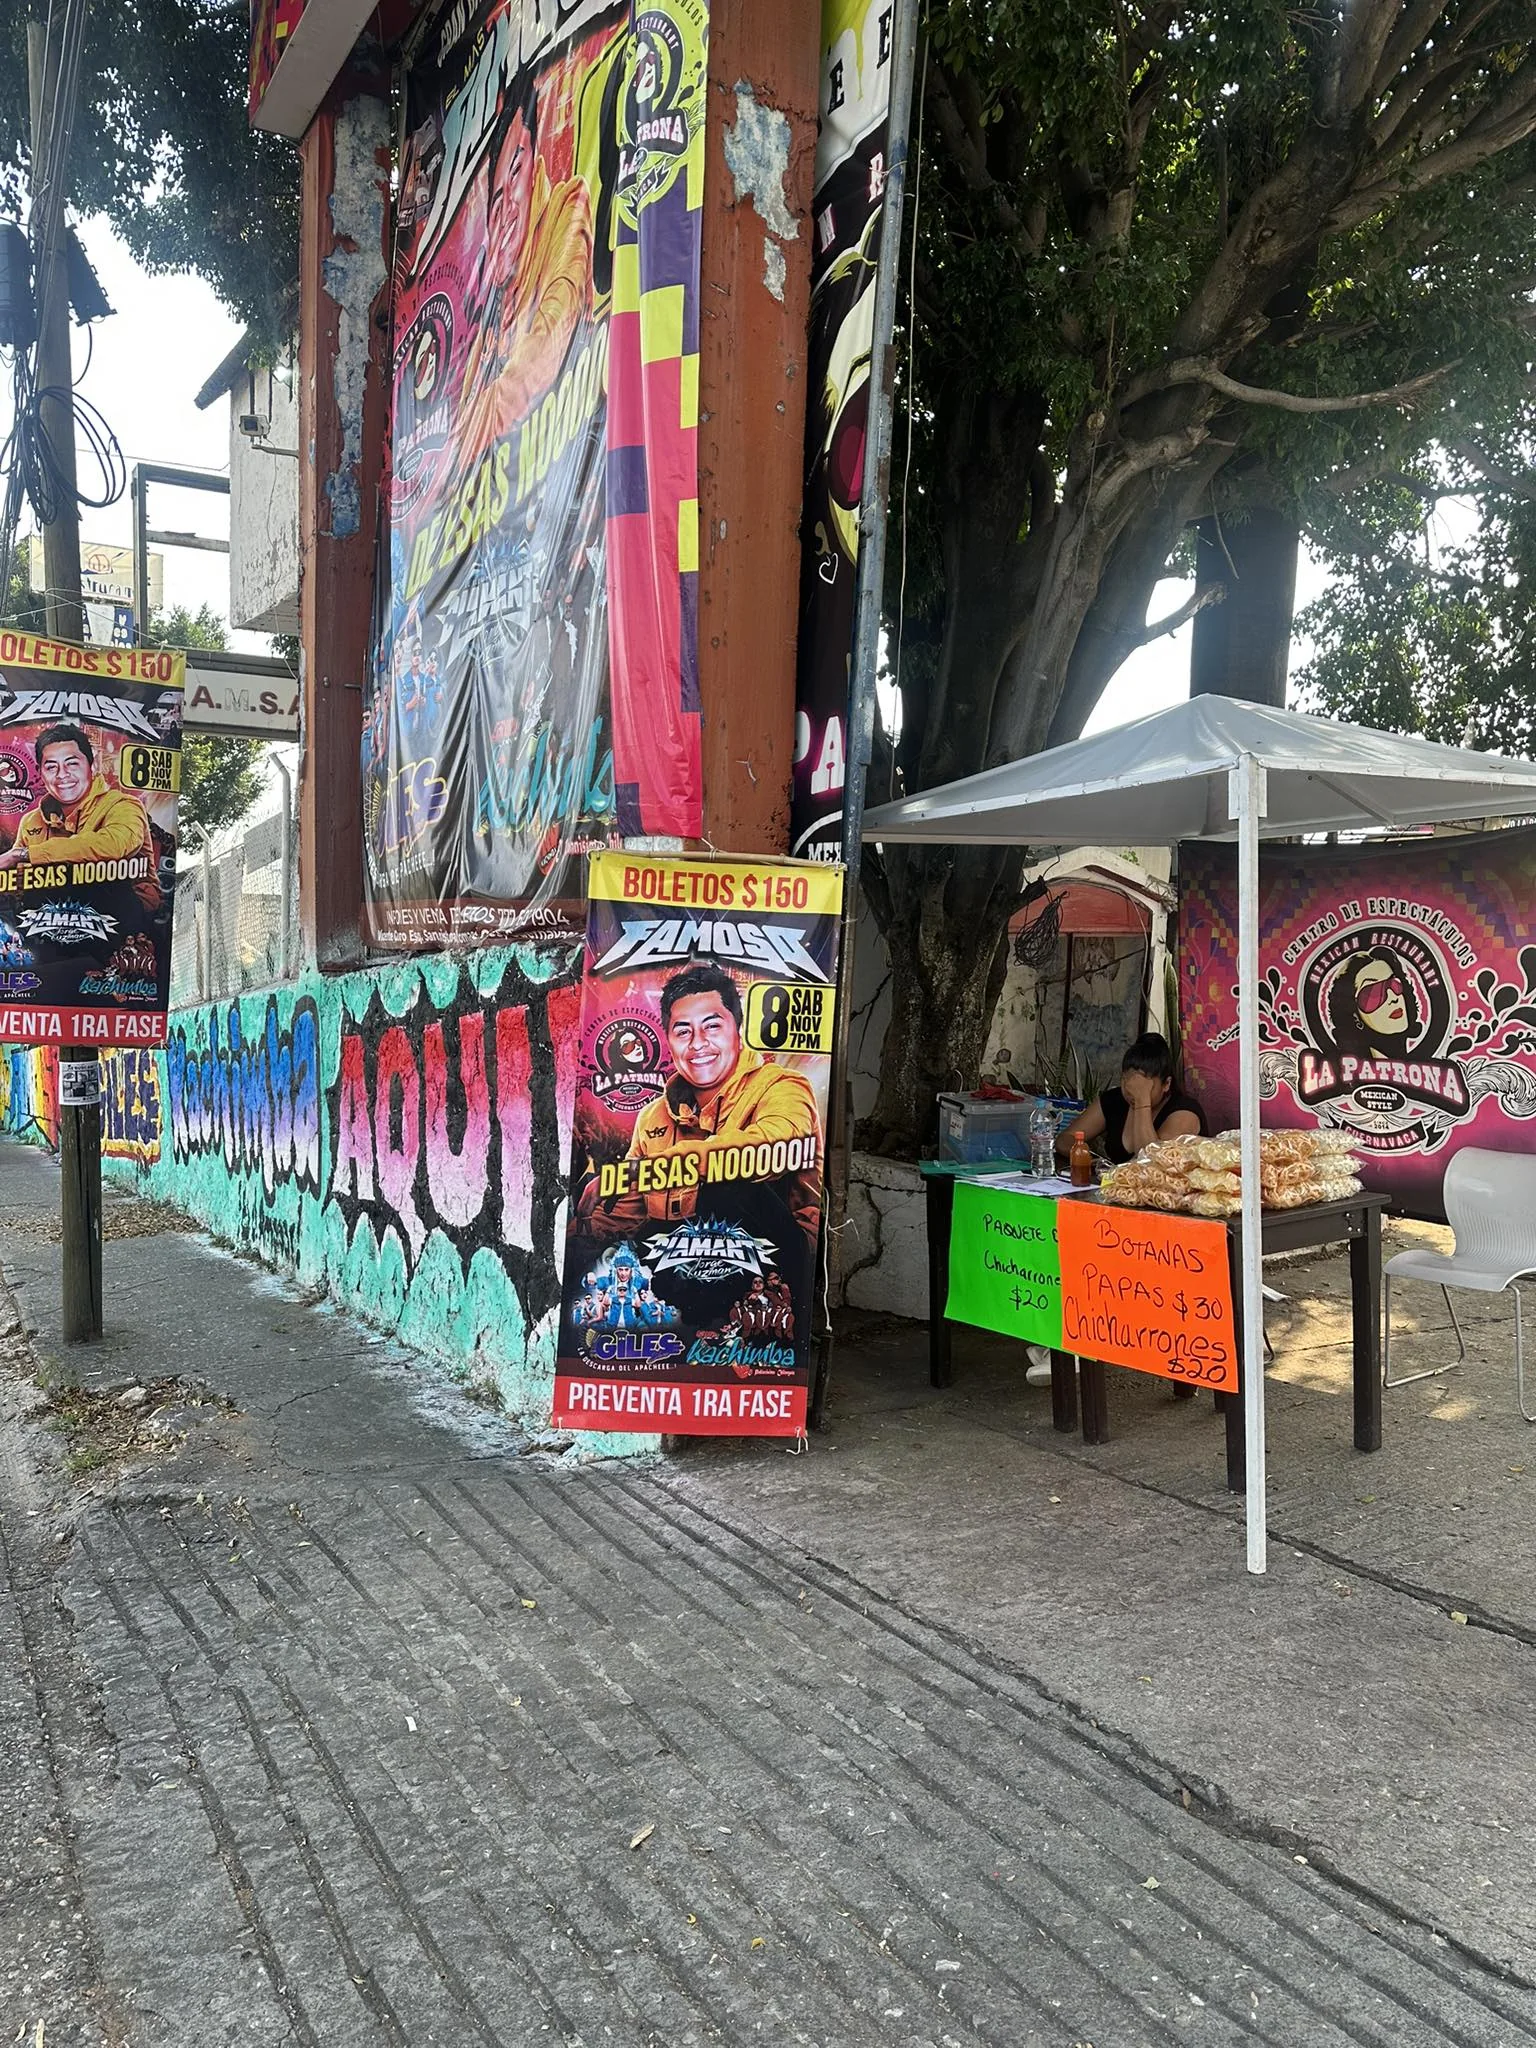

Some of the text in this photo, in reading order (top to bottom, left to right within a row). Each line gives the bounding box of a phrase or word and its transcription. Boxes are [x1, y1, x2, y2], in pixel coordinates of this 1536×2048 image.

[637, 115, 684, 145] TRONA
[106, 649, 172, 682] $150
[2, 690, 161, 741] FAMOSO
[130, 748, 173, 788] 8 SAB
[150, 778, 172, 791] 7PM
[151, 766, 172, 780] NOV
[24, 864, 67, 890] ESAS
[623, 867, 809, 909] BOLETOS $150
[1283, 897, 1477, 970] CENTRO DE ESPECTÁCULOS
[591, 918, 830, 984] FAMOSO
[1309, 932, 1439, 989] MEXICAN RESTAURANT
[71, 1013, 110, 1038] 1RA
[115, 1013, 164, 1038] FASE
[760, 986, 823, 1049] 8 SAB
[790, 1014, 821, 1033] NOV
[790, 1031, 821, 1050] 7PM
[595, 1075, 612, 1093] LA
[614, 1072, 666, 1088] PATRONA
[1342, 1056, 1463, 1105] PATRONA
[1360, 1090, 1398, 1101] MEXICAN
[1366, 1101, 1393, 1110] STYLE
[600, 1135, 816, 1197] DE ESAS NOOOOO!!
[983, 1213, 1046, 1243] PAQUETE
[1093, 1218, 1204, 1273] BOTANAS
[1009, 1286, 1049, 1312] $20
[1082, 1263, 1164, 1308] PAPAS
[1063, 1296, 1228, 1362] Chicharrones
[594, 1329, 686, 1364] GILES
[582, 1356, 615, 1371] DESCARGA
[1168, 1357, 1227, 1384] $20
[568, 1382, 793, 1419] PREVENTA 1RA FASE
